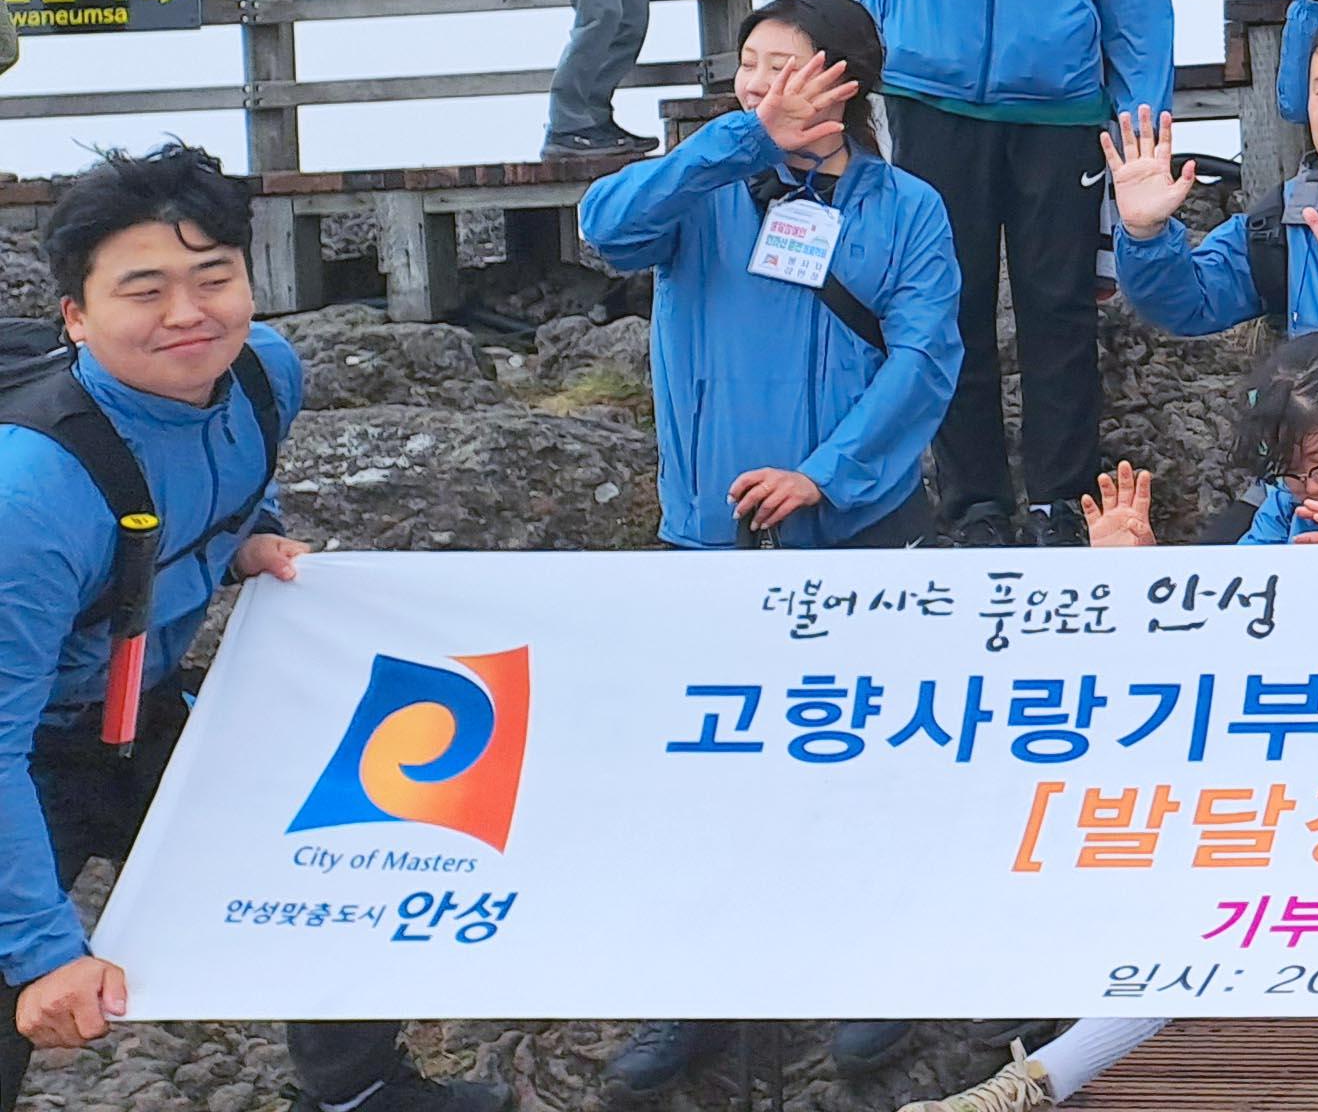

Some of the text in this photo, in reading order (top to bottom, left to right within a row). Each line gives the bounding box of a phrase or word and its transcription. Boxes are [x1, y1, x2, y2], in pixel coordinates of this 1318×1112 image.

[9, 6, 128, 27] waneumsa
[762, 572, 1279, 652] 더불어 사는 풍요로운 안성
[293, 846, 477, 873] City of Masters
[224, 890, 518, 944] 안성맞춤도시 안성
[1103, 964, 1244, 997] 일시:
